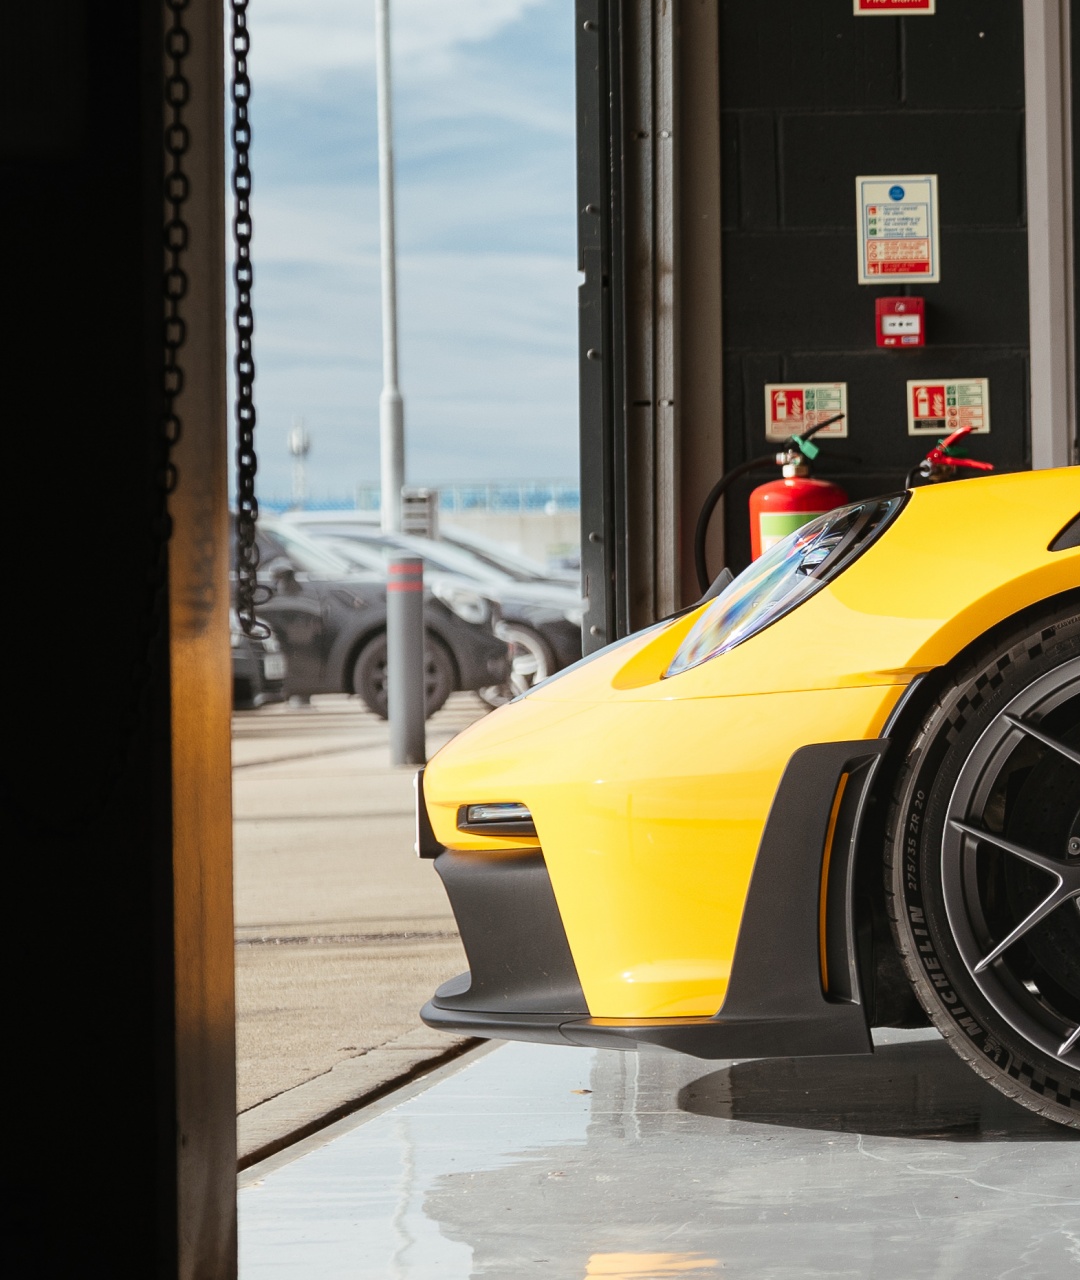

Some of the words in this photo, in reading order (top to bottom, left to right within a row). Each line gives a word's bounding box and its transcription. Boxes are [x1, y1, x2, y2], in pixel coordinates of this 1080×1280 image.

[914, 789, 926, 809] 20
[909, 812, 920, 832] ZR
[907, 834, 916, 890] 275/35
[910, 905, 981, 1037] MICHELIN
